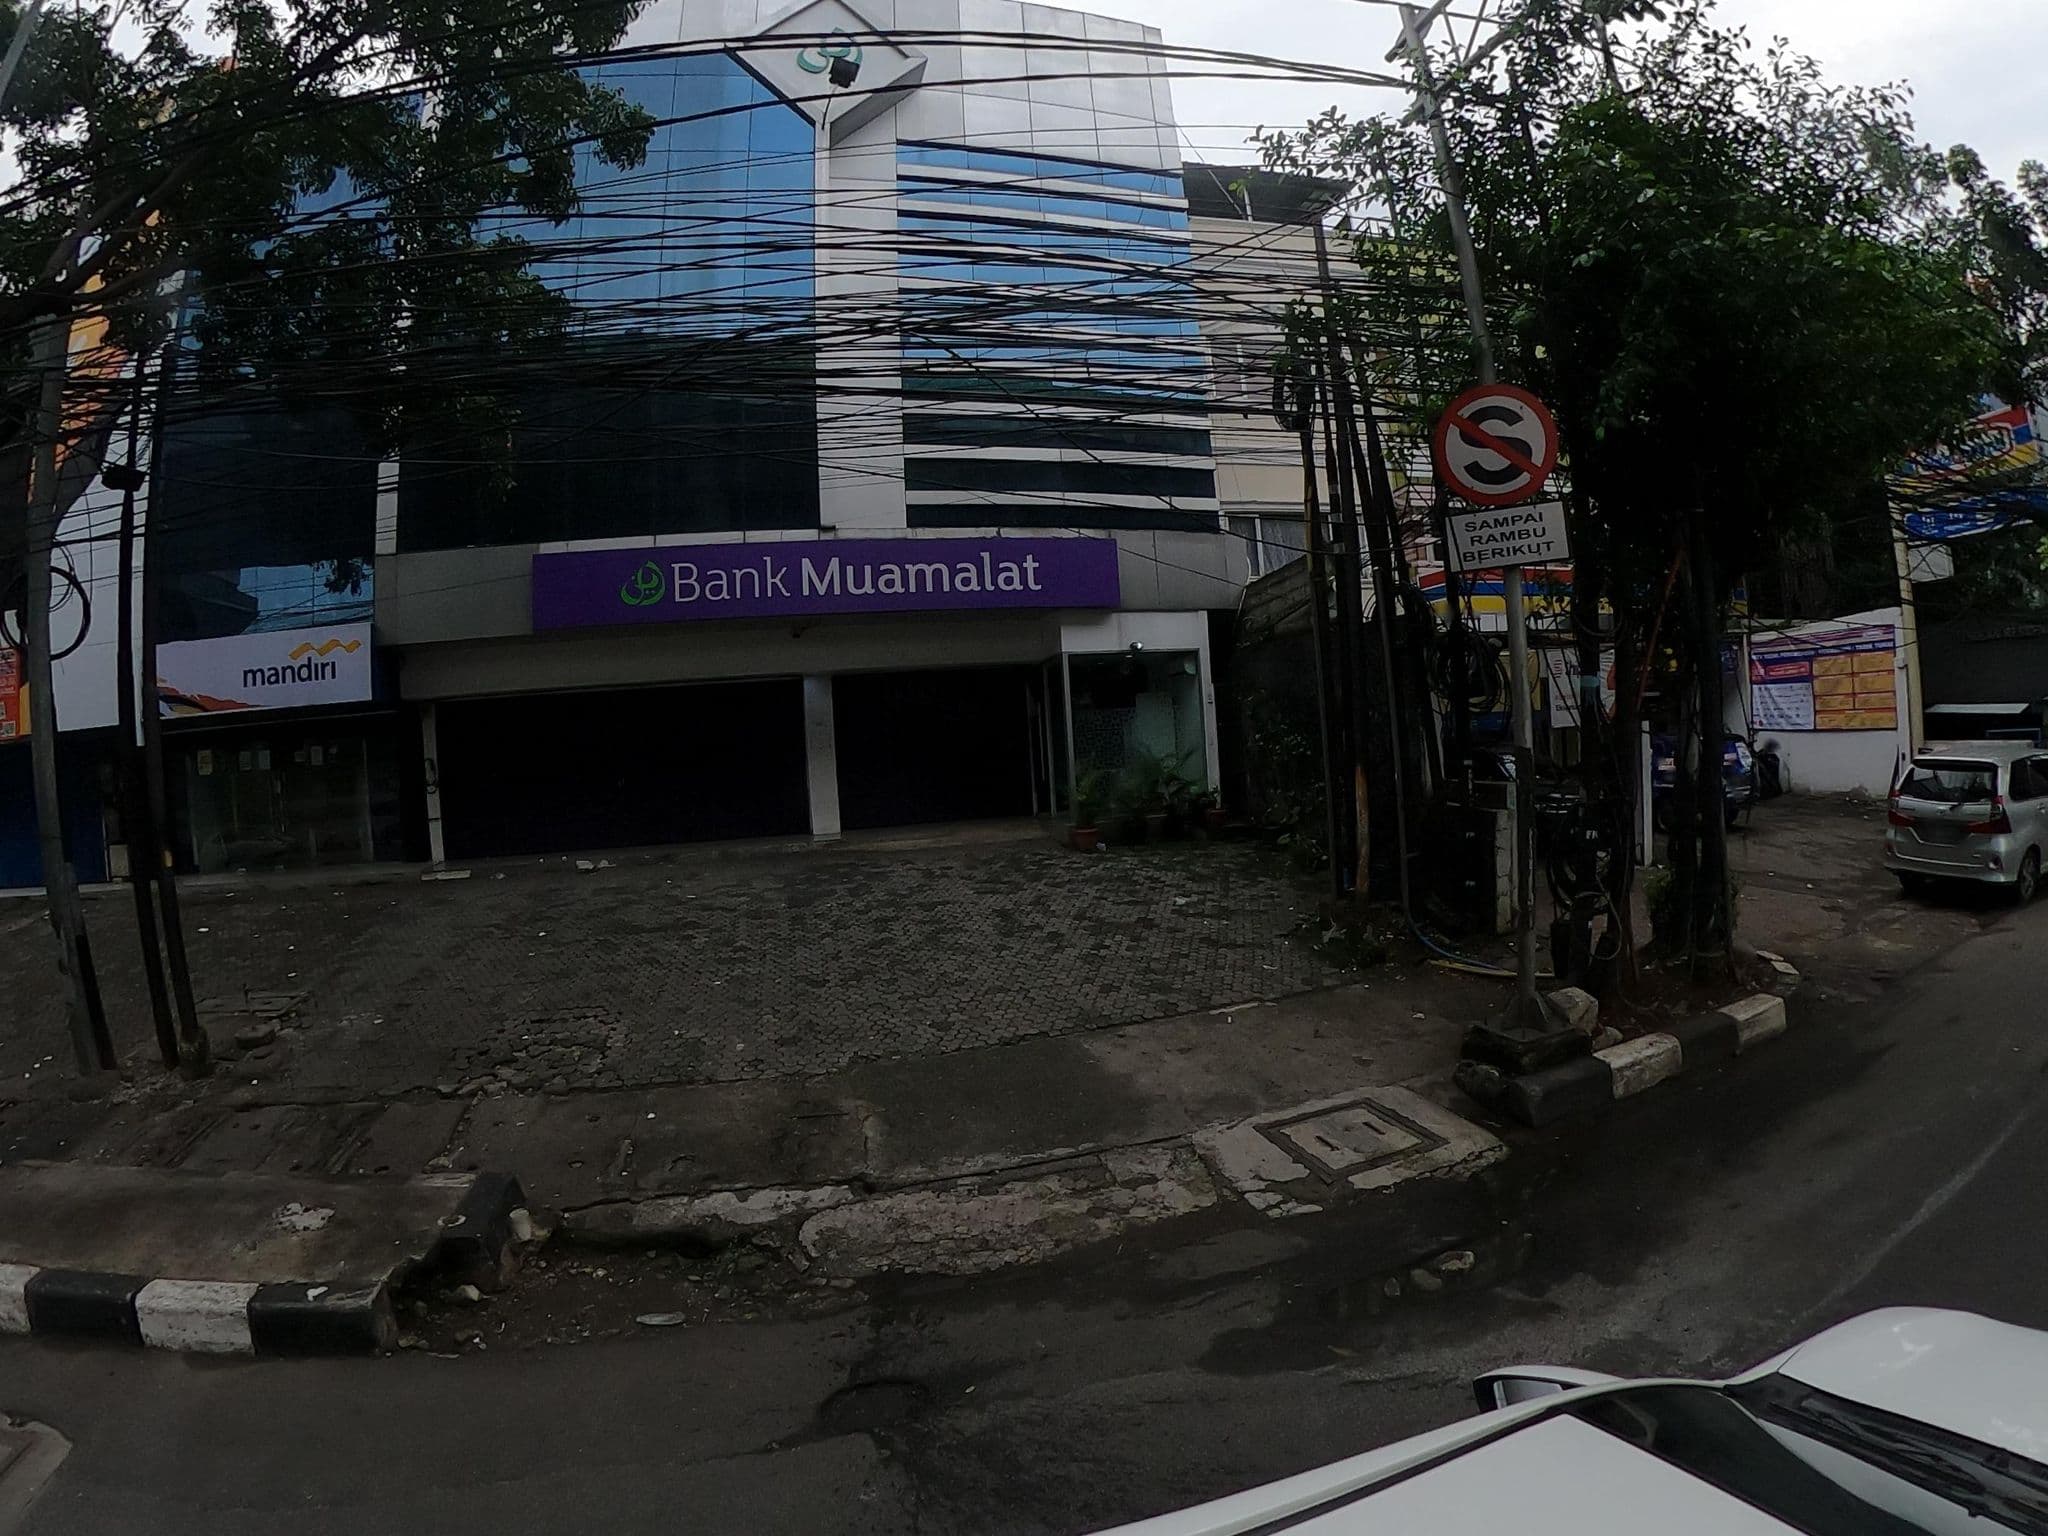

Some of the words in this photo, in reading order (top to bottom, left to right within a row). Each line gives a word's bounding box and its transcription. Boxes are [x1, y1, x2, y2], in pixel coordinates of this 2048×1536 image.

[1465, 512, 1544, 533] SAMPAI
[1470, 526, 1547, 547] RAMBU
[1463, 541, 1554, 563] BERIKUT
[671, 556, 791, 602] Bank
[801, 551, 1043, 596] Muamalat
[243, 656, 337, 688] mandiri
